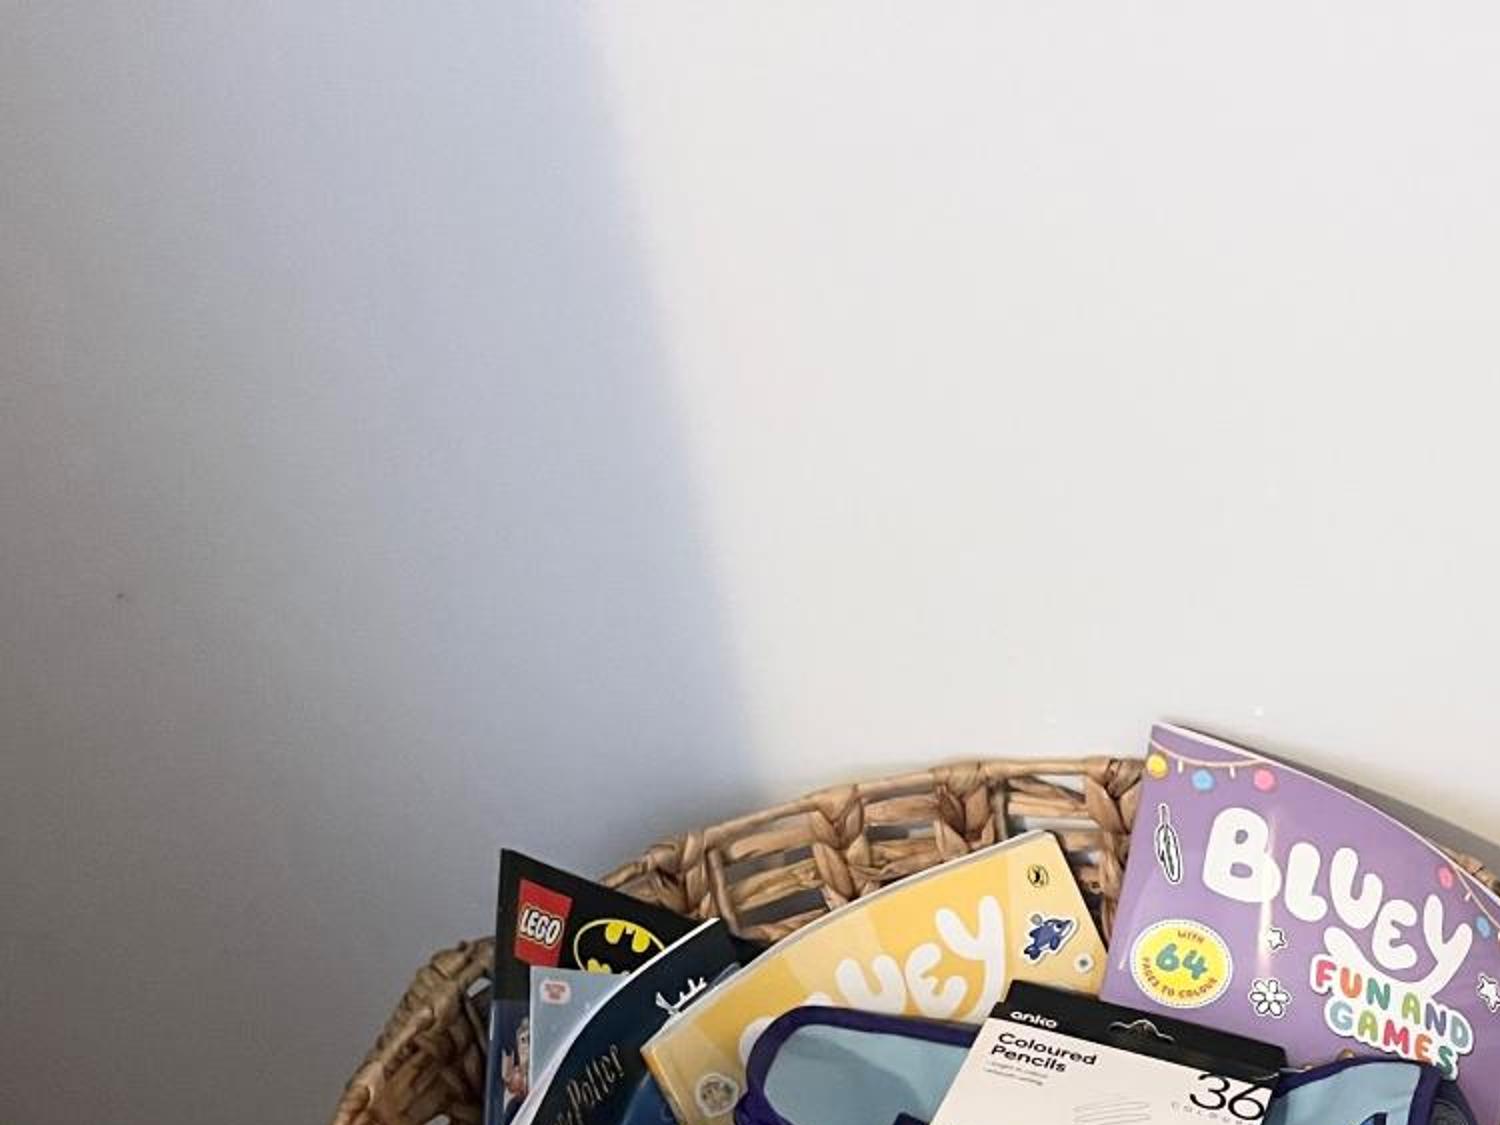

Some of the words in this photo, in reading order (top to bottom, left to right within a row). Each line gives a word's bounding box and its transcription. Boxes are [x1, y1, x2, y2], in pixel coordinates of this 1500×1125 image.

[1203, 806, 1474, 993] BLUEY
[520, 907, 562, 946] LEGO
[1156, 943, 1208, 980] 64
[1161, 985, 1175, 996] TO
[1315, 959, 1391, 1010] FUN
[1401, 992, 1472, 1048] AND
[1010, 1010, 1058, 1029] anko
[1329, 1001, 1454, 1074] GAMES
[990, 1045, 1066, 1074] Pencils
[998, 1032, 1098, 1066] Coloured
[1189, 1072, 1267, 1121] 36
